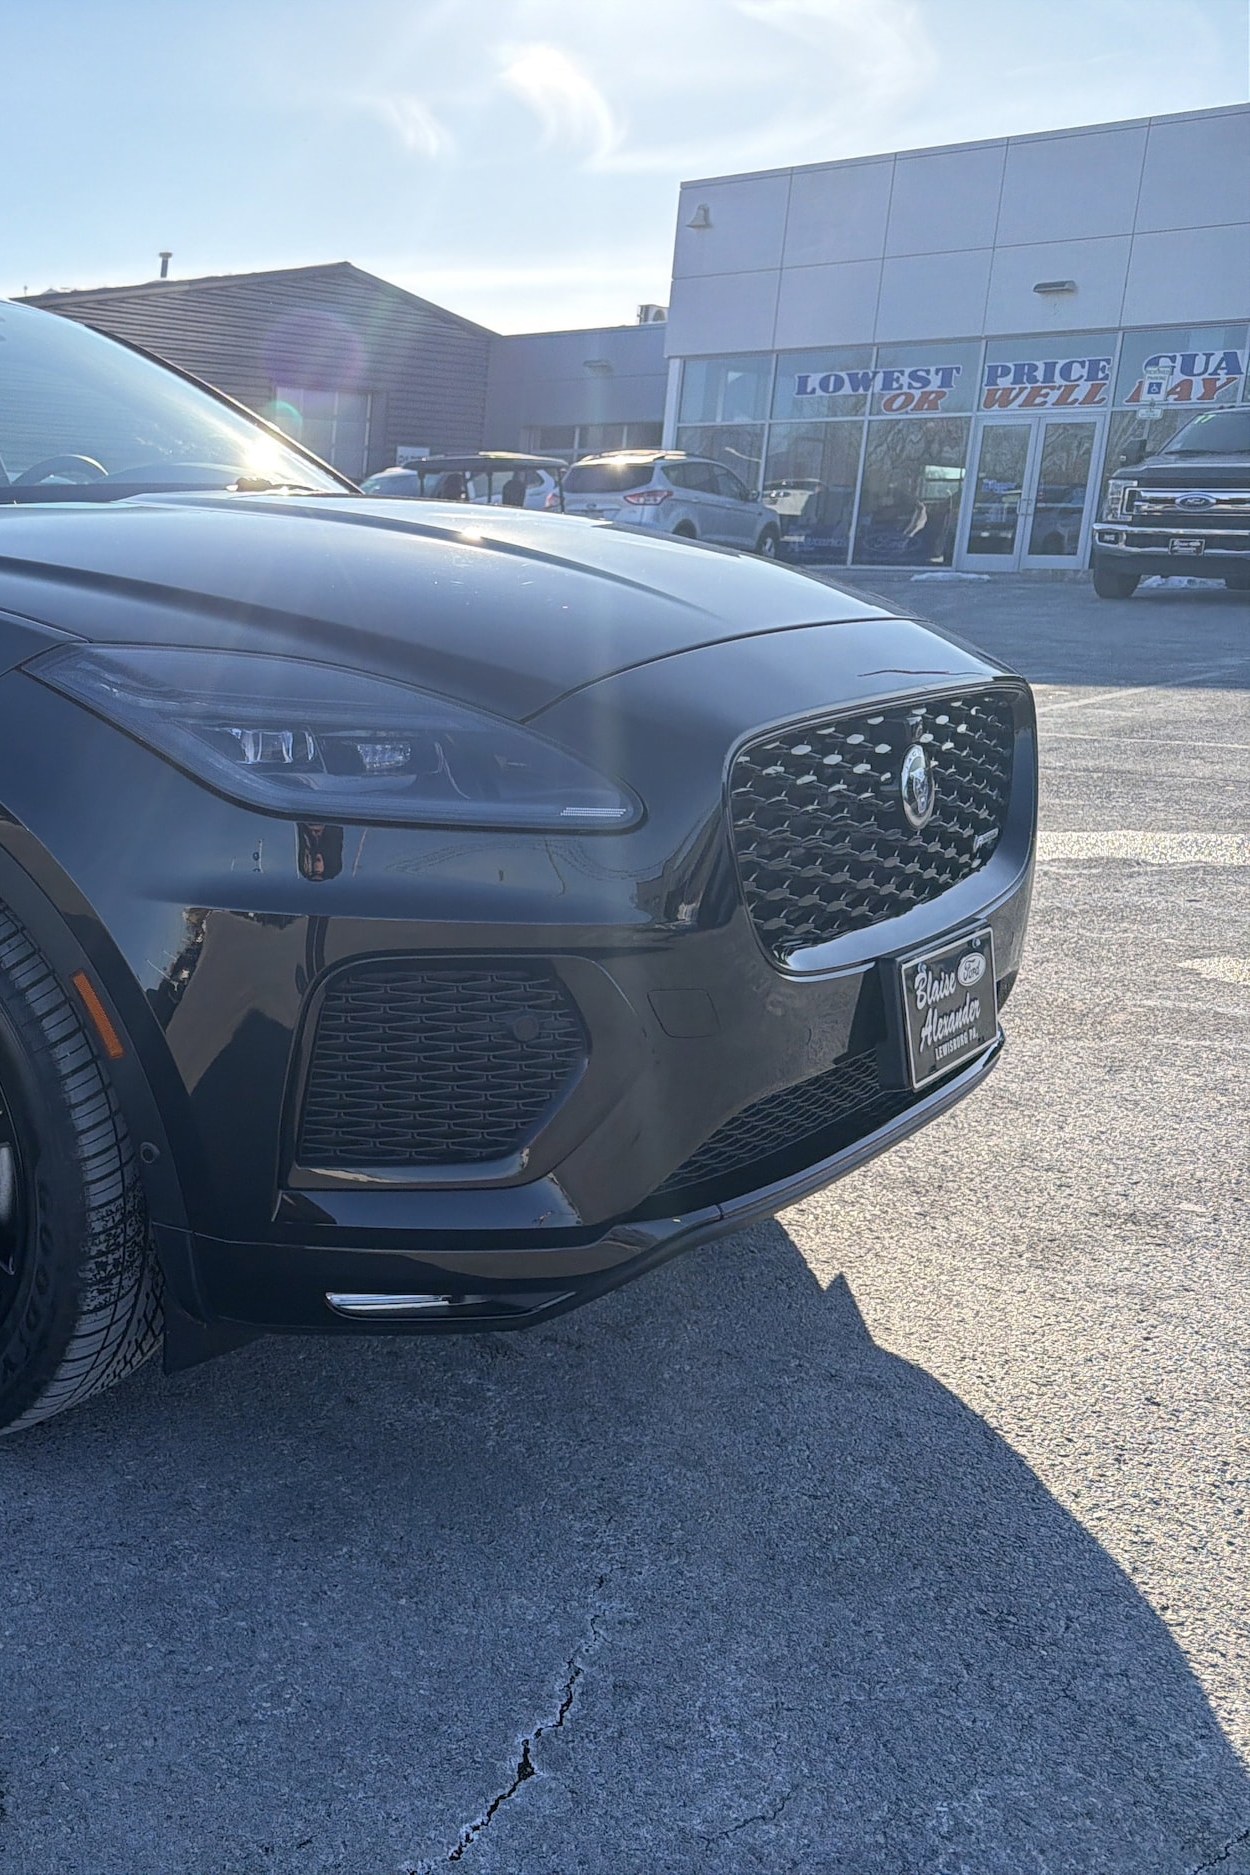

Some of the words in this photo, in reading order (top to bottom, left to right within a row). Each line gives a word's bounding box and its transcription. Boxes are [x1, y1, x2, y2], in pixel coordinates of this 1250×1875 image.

[795, 365, 962, 396] LOWEST
[983, 357, 1112, 387] PRICE
[882, 390, 947, 413] OR
[982, 382, 1109, 410] WE'LL
[962, 958, 982, 983] Ford
[914, 971, 957, 1010] Blaise
[920, 991, 981, 1053] Alexander
